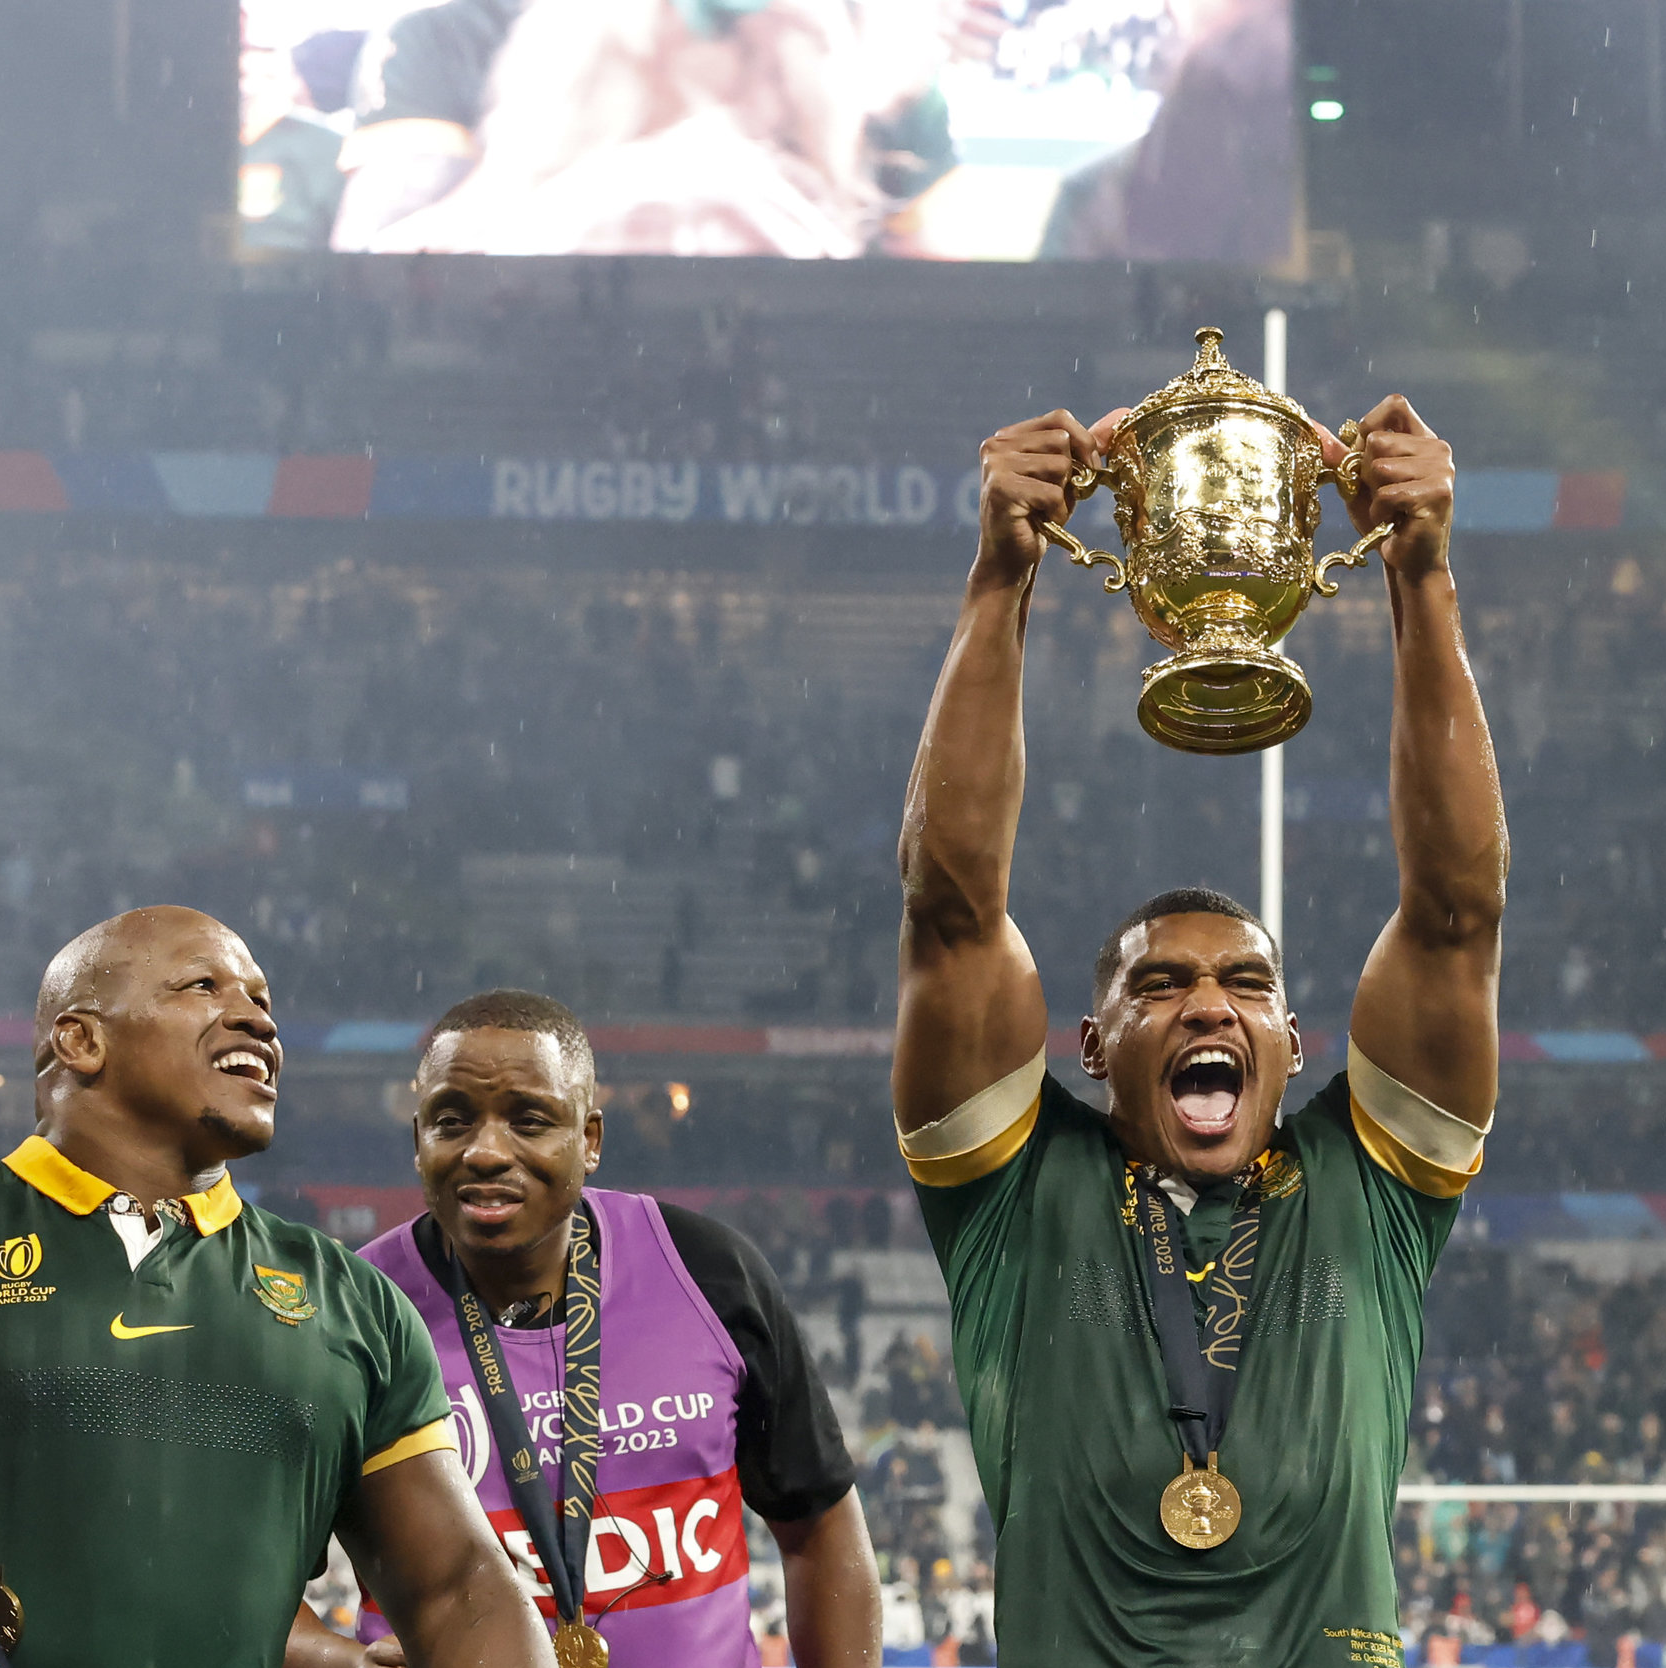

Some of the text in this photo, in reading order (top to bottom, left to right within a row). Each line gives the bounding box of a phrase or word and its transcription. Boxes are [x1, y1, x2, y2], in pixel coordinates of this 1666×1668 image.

[718, 463, 938, 524] WORLD
[1154, 1236, 1175, 1276] 2023
[1, 1281, 32, 1290] RUGBY
[30, 1286, 57, 1297] CUP
[24, 1294, 47, 1303] 2023
[460, 1291, 484, 1333] 2023
[651, 1392, 715, 1424] CUP
[614, 1428, 679, 1456] 2023
[503, 1498, 723, 1598] EDIC
[1324, 1628, 1349, 1638] South
[1351, 1628, 1372, 1639] Africa
[1351, 1640, 1370, 1651] RWC
[1370, 1643, 1386, 1653] 2023
[1351, 1652, 1361, 1662] 28
